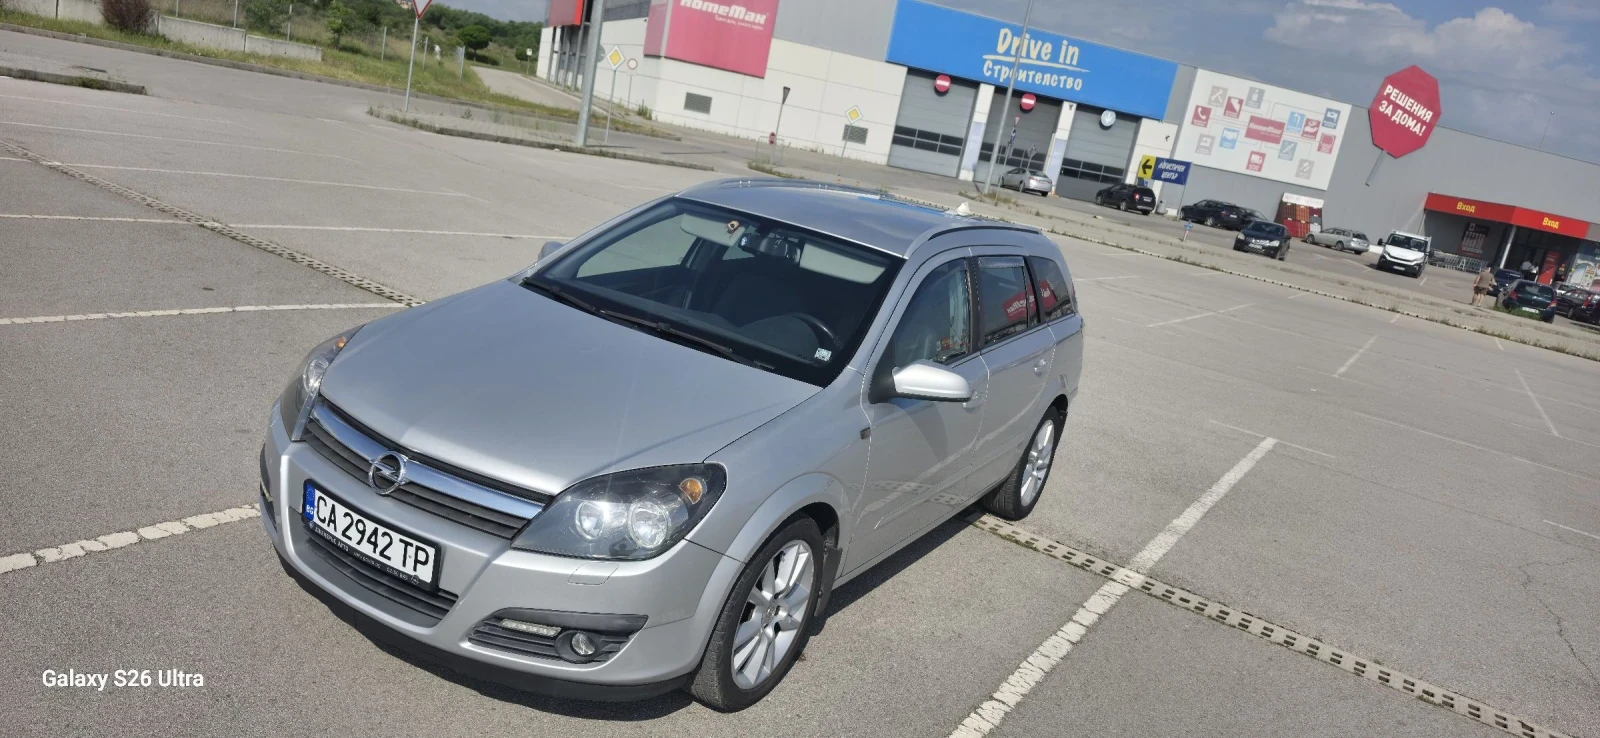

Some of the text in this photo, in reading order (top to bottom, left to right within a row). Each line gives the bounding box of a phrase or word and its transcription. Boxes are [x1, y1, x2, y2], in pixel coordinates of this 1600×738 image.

[996, 28, 1080, 66] Drive in
[983, 60, 1083, 91] Строителство
[1379, 100, 1426, 136] ЗА ДОМА!
[1383, 84, 1433, 123] РЕШЕНИЯ
[1456, 201, 1476, 213] Вход
[1542, 217, 1560, 229] Вход
[306, 504, 314, 515] BG
[316, 495, 338, 532] CA
[341, 512, 394, 562] 2942
[399, 538, 430, 573] TP
